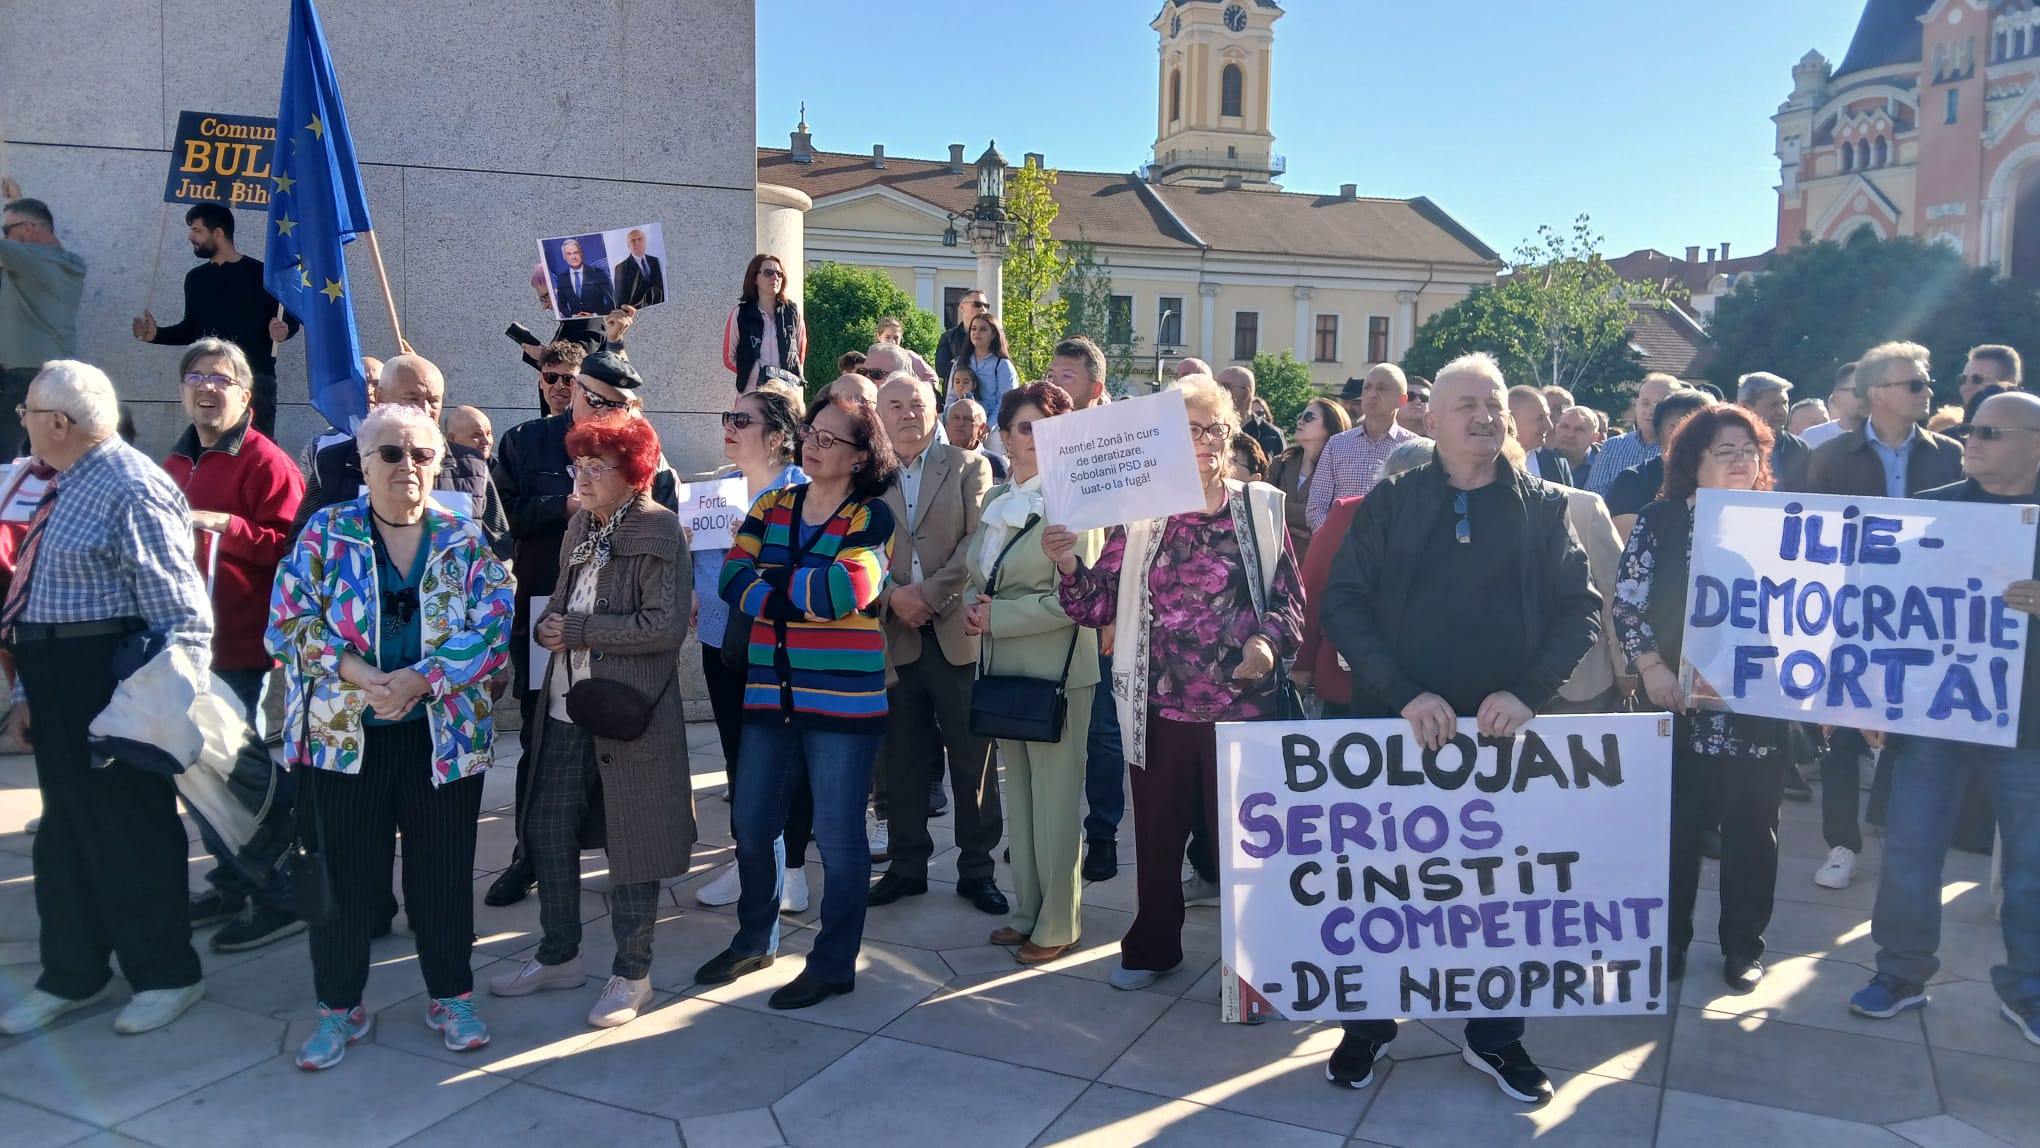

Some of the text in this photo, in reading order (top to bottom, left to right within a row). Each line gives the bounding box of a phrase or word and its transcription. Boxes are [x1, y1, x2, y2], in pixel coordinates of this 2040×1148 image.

[180, 140, 271, 178] BUL
[176, 178, 271, 204] Jud. Bih
[1097, 434, 1123, 448] Zonă
[1136, 428, 1160, 440] curs
[1077, 457, 1089, 467] de
[1119, 460, 1141, 473] PSD
[1143, 458, 1157, 468] au
[1081, 472, 1151, 495] luat-o la fugă!
[1281, 731, 1624, 793] BOLOJAN
[1320, 897, 1664, 956] COMPETENT
